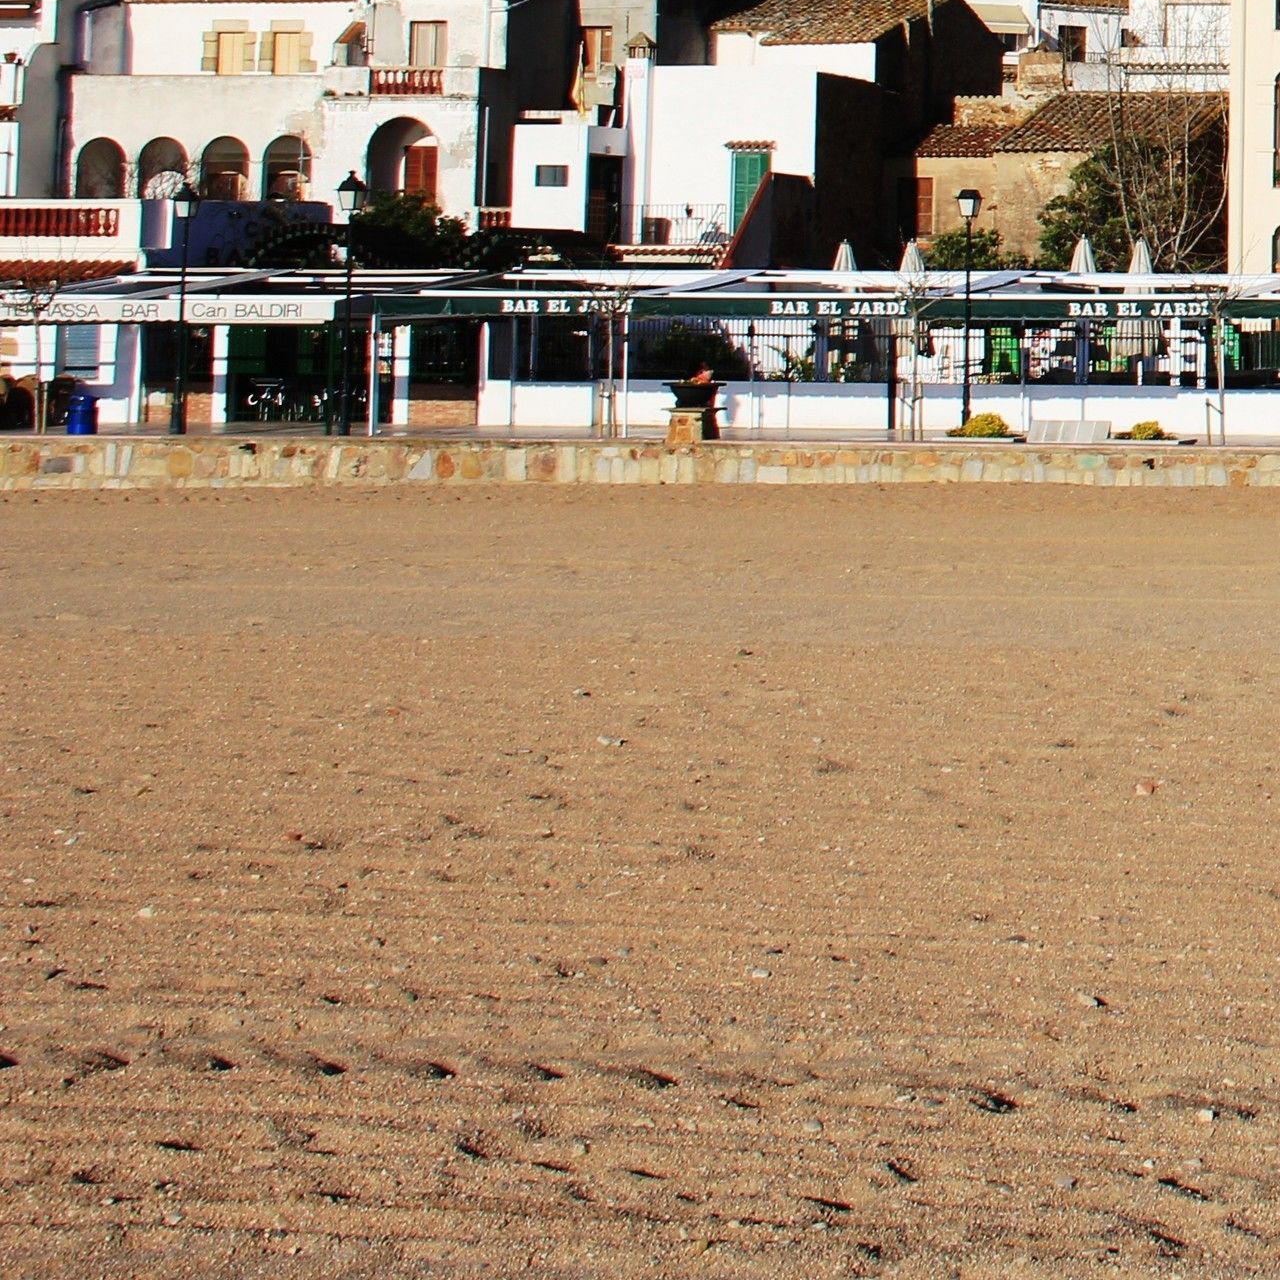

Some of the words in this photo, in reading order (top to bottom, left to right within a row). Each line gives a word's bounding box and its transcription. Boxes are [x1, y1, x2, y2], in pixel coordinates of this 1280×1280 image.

[122, 304, 160, 318] BAR
[192, 303, 227, 318] Can
[235, 303, 302, 318] BALDIRI
[502, 299, 539, 313] BAR
[547, 299, 570, 313] EL
[771, 301, 809, 315] BAR
[818, 301, 842, 315] EL
[1069, 302, 1108, 316] BAR
[1117, 302, 1142, 316] EL
